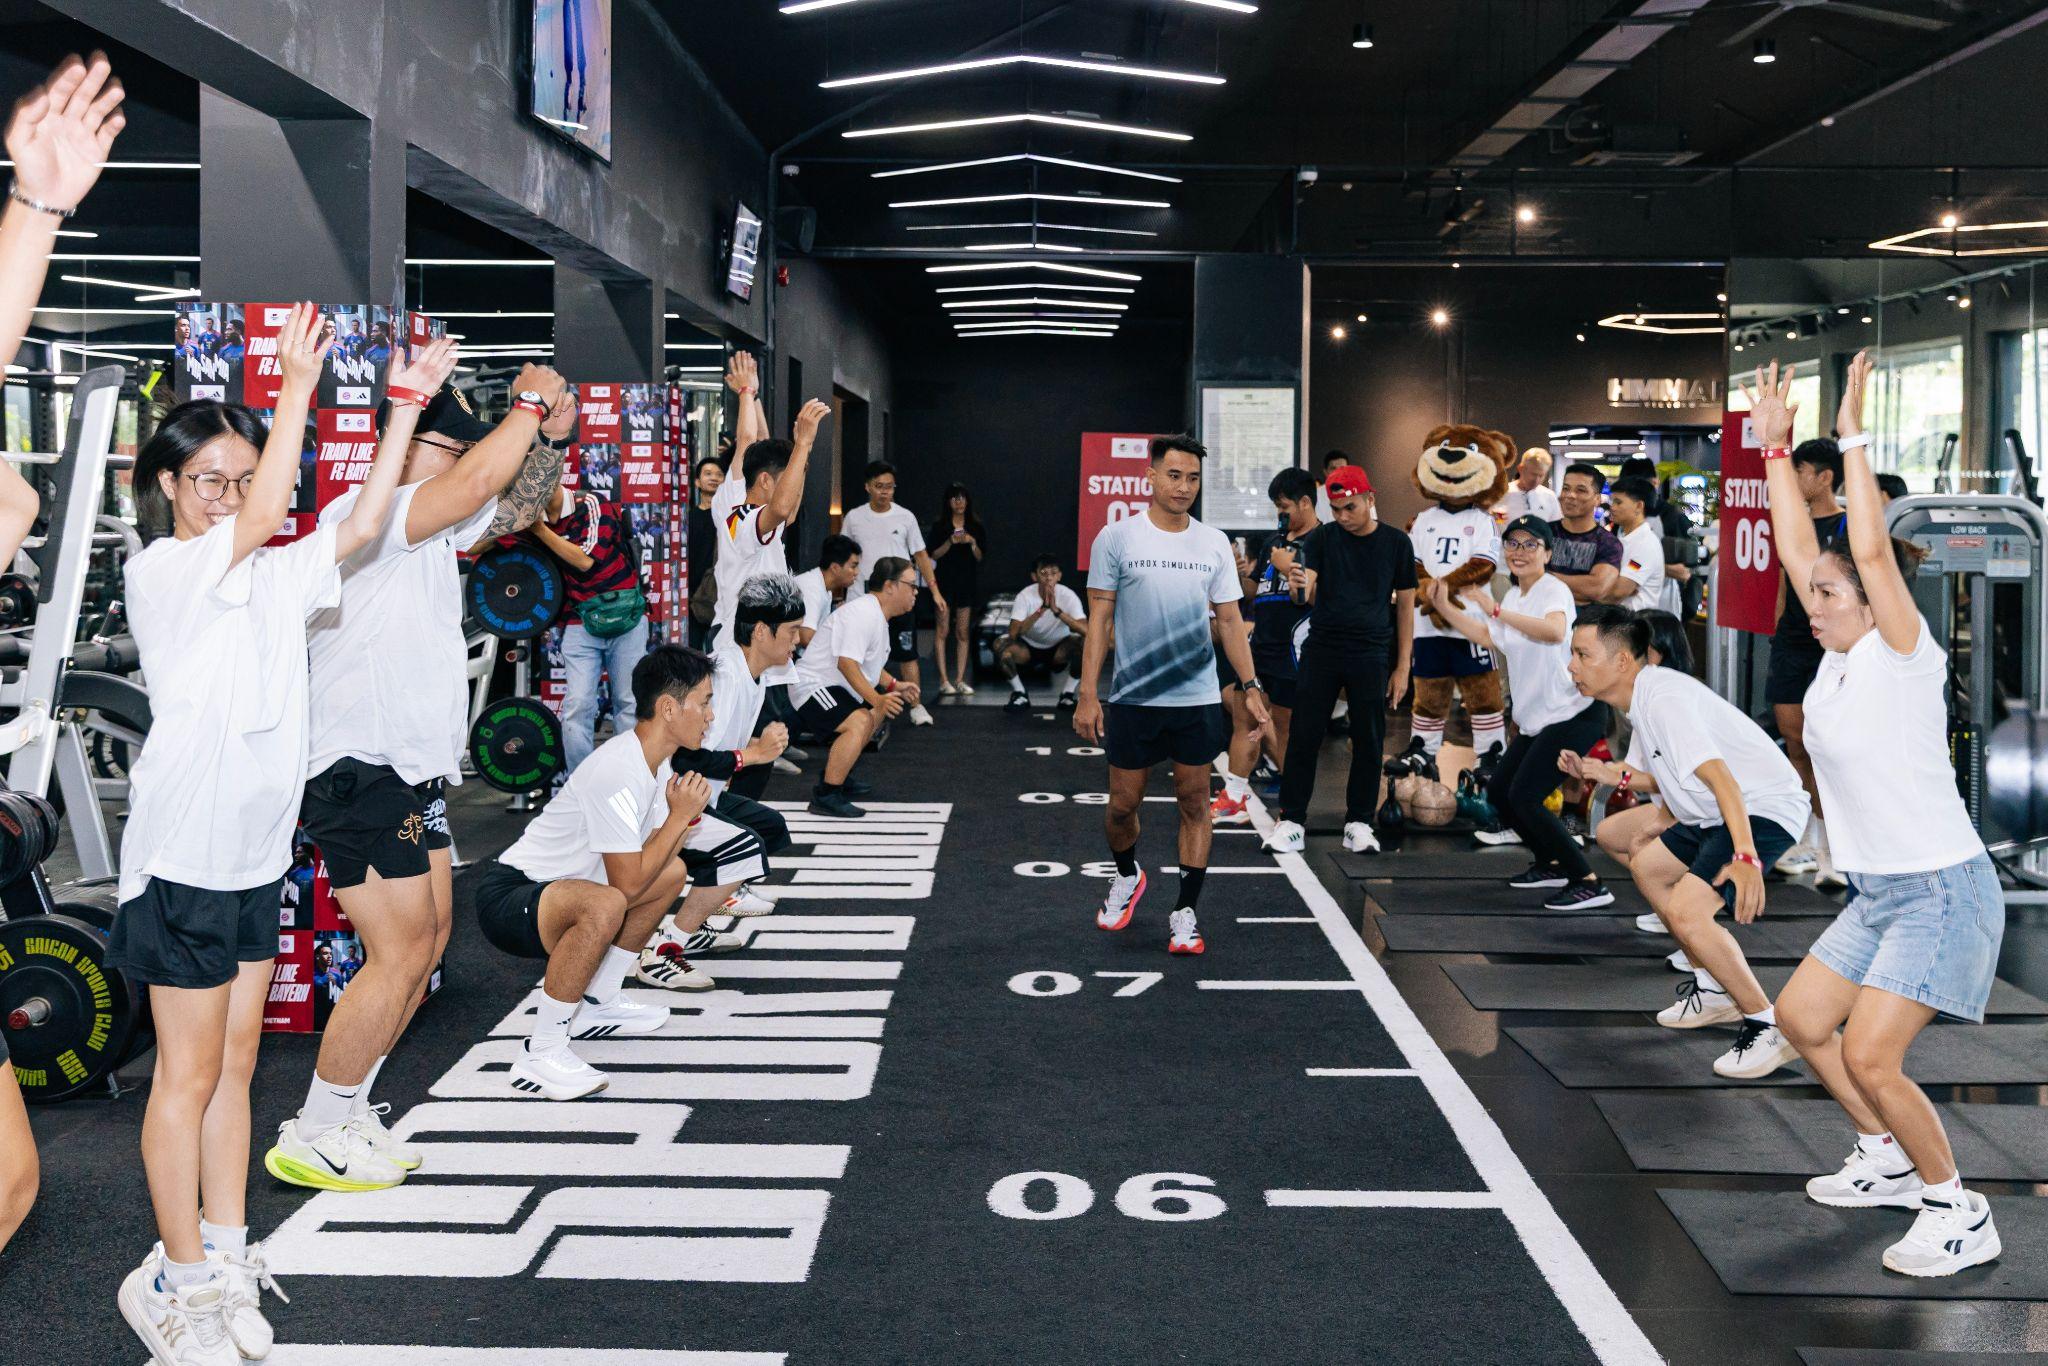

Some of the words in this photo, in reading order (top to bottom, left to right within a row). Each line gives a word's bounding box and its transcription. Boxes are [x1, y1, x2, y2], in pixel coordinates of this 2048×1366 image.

[320, 442, 353, 461] TRAIN
[350, 442, 377, 461] LIKE
[329, 462, 347, 481] FC
[1088, 475, 1153, 496] STATIO
[1725, 478, 1771, 509] STATIO
[1735, 517, 1771, 572] 06
[1128, 559, 1157, 569] HYROX
[1161, 559, 1212, 572] SIMULATION
[275, 963, 300, 983] LIKE
[268, 983, 311, 1003] BAYERN
[1007, 970, 1164, 997] 07
[986, 1171, 1229, 1222] 06
